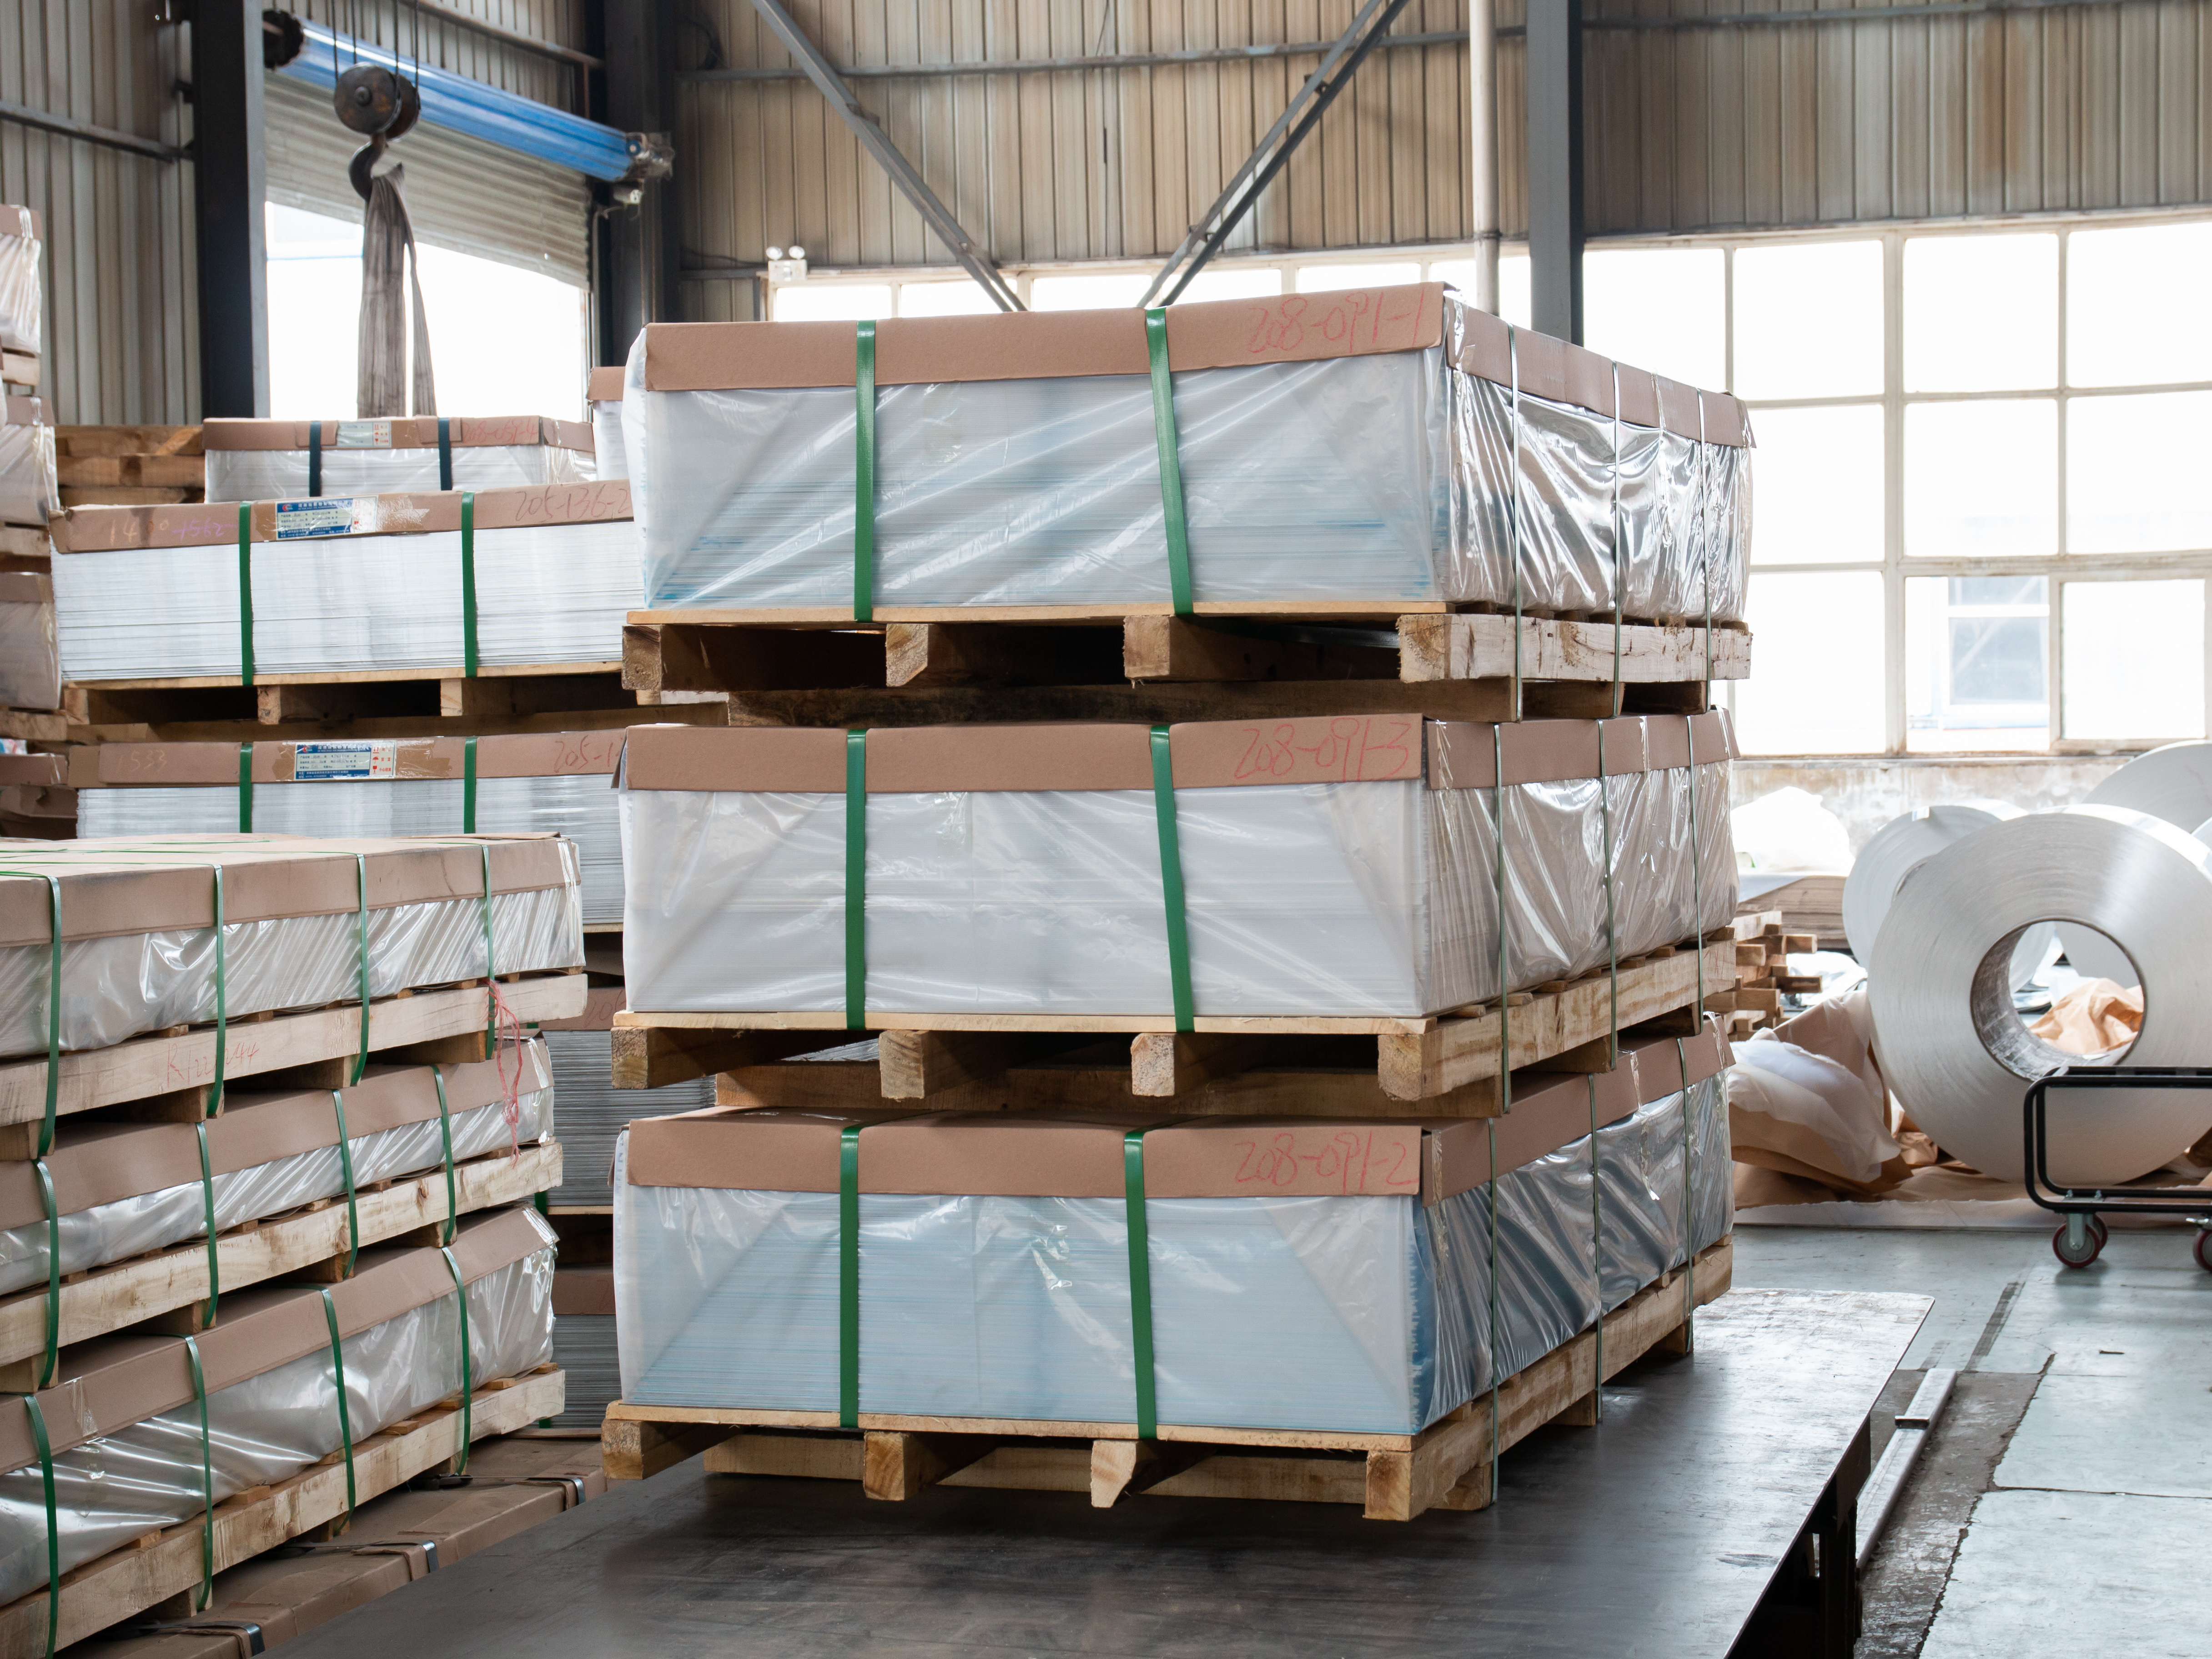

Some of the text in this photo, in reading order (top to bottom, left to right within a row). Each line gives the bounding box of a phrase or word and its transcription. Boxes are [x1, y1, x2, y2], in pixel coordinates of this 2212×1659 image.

[1247, 287, 1425, 354] 208-091-1
[515, 483, 630, 523] 205-136-2
[1234, 717, 1411, 782] 208-091-3
[1234, 1131, 1419, 1195] 208-091-2
